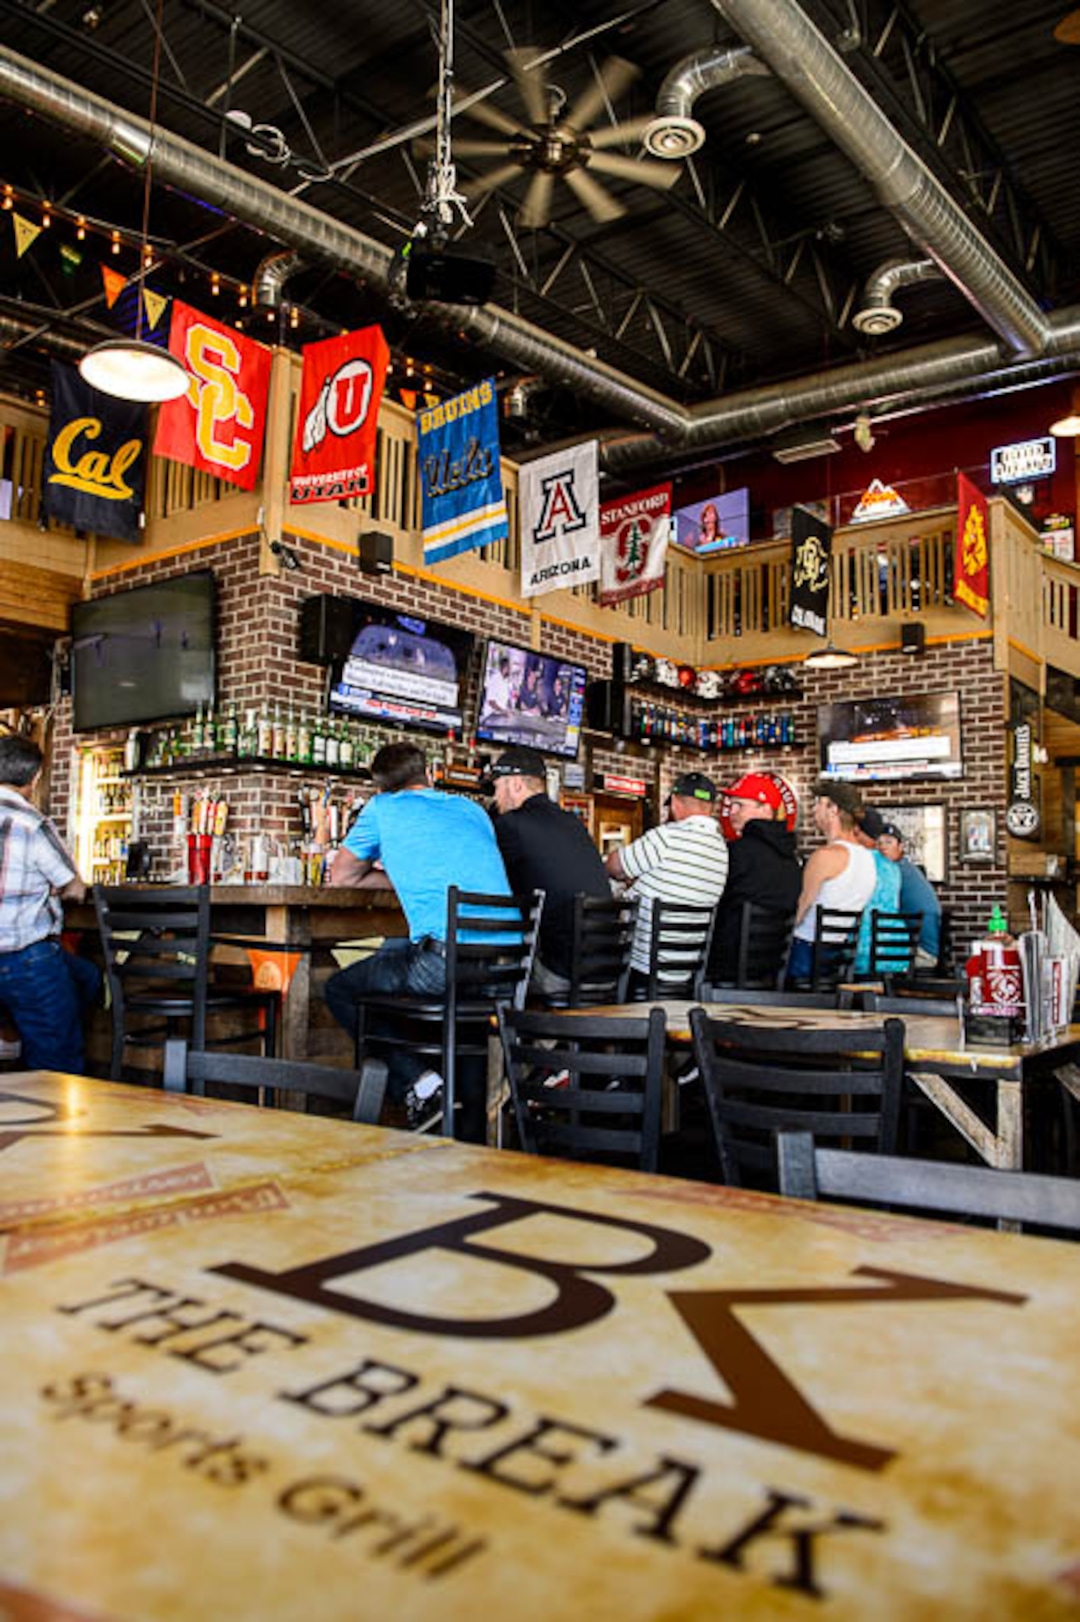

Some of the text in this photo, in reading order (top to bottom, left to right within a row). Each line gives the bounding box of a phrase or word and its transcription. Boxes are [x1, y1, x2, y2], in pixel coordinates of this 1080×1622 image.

[335, 371, 369, 429] U
[420, 380, 492, 435] BRUINS
[51, 416, 143, 488] Cal
[291, 476, 368, 500] UTAH
[533, 467, 587, 545] A
[601, 491, 669, 525] STANFORD
[530, 556, 592, 586] ARIZONA
[57, 1277, 887, 1602] THE BREAK
[40, 1371, 490, 1583] Sports Grill
